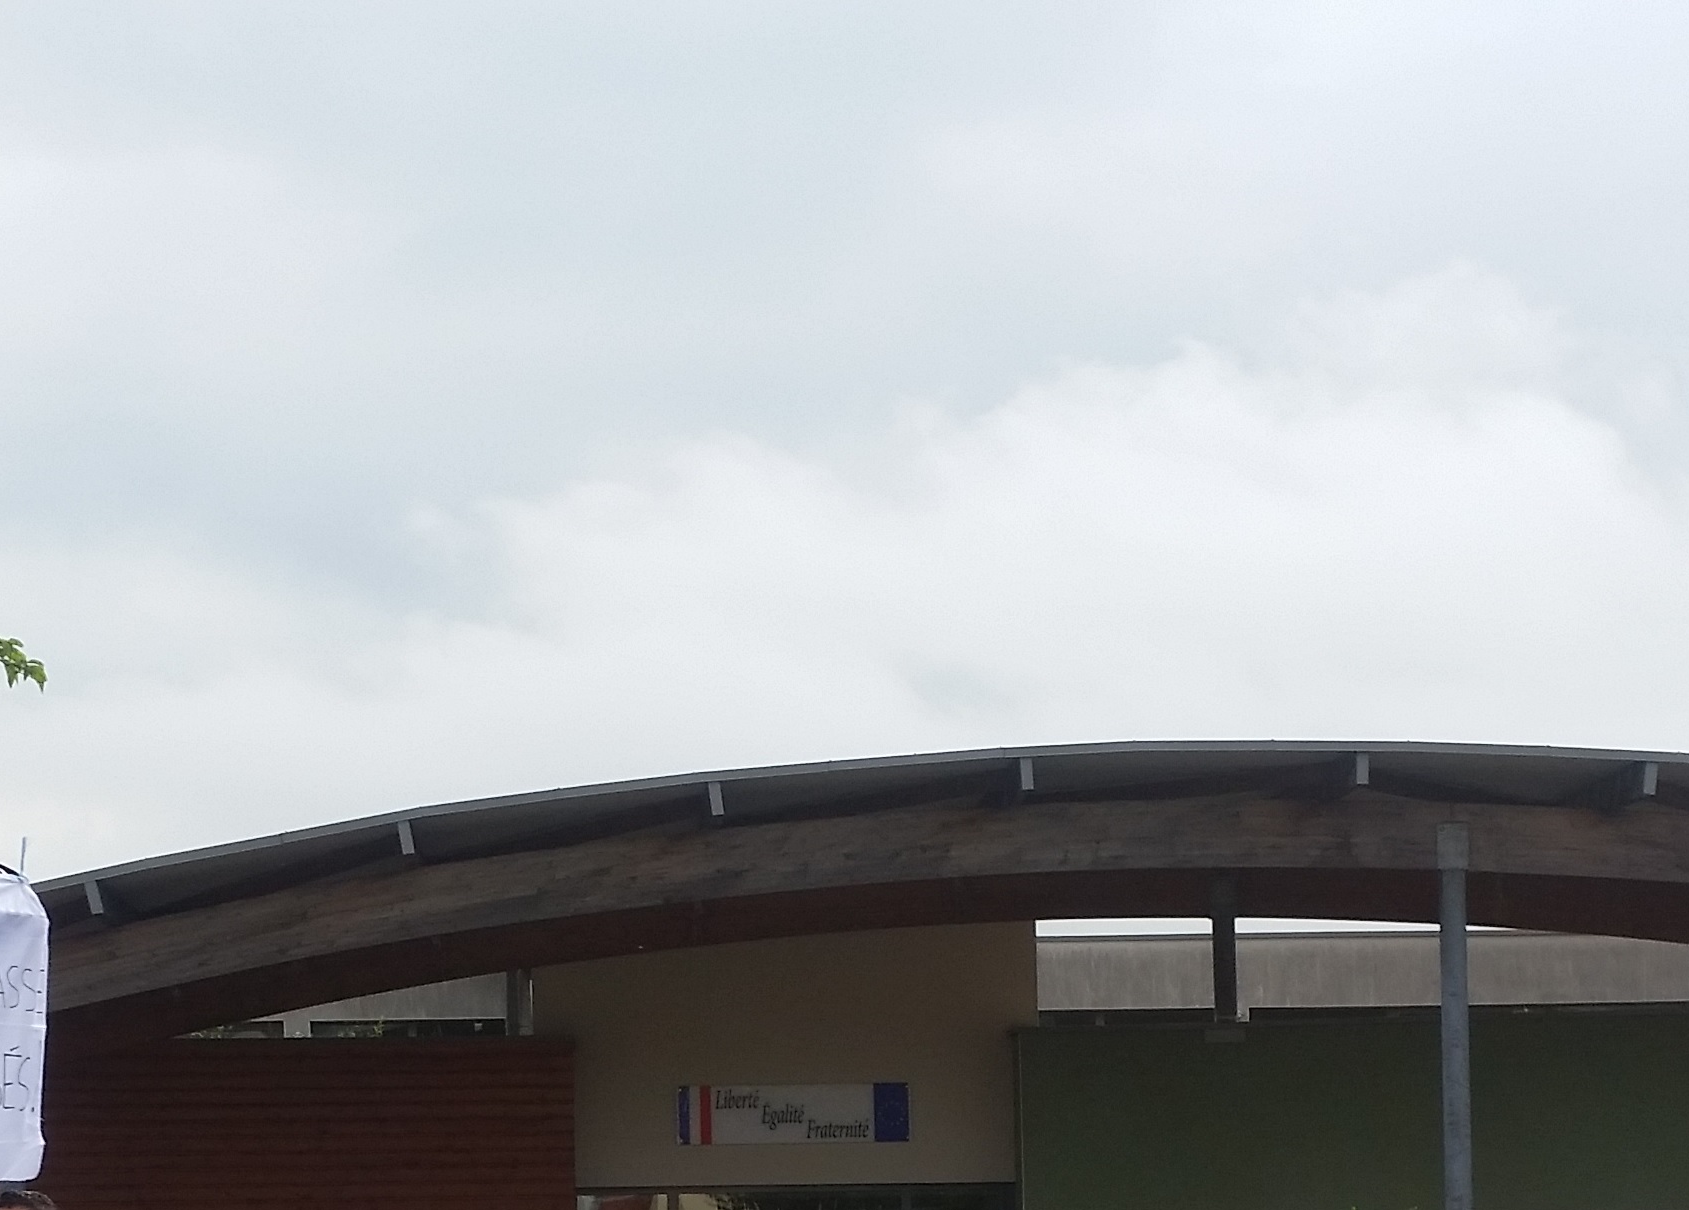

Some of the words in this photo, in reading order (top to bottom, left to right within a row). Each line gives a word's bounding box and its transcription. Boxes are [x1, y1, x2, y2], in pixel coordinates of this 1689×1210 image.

[715, 1089, 760, 1111] Liberté
[761, 1103, 805, 1130] Égalité
[806, 1119, 870, 1139] Fraternité
